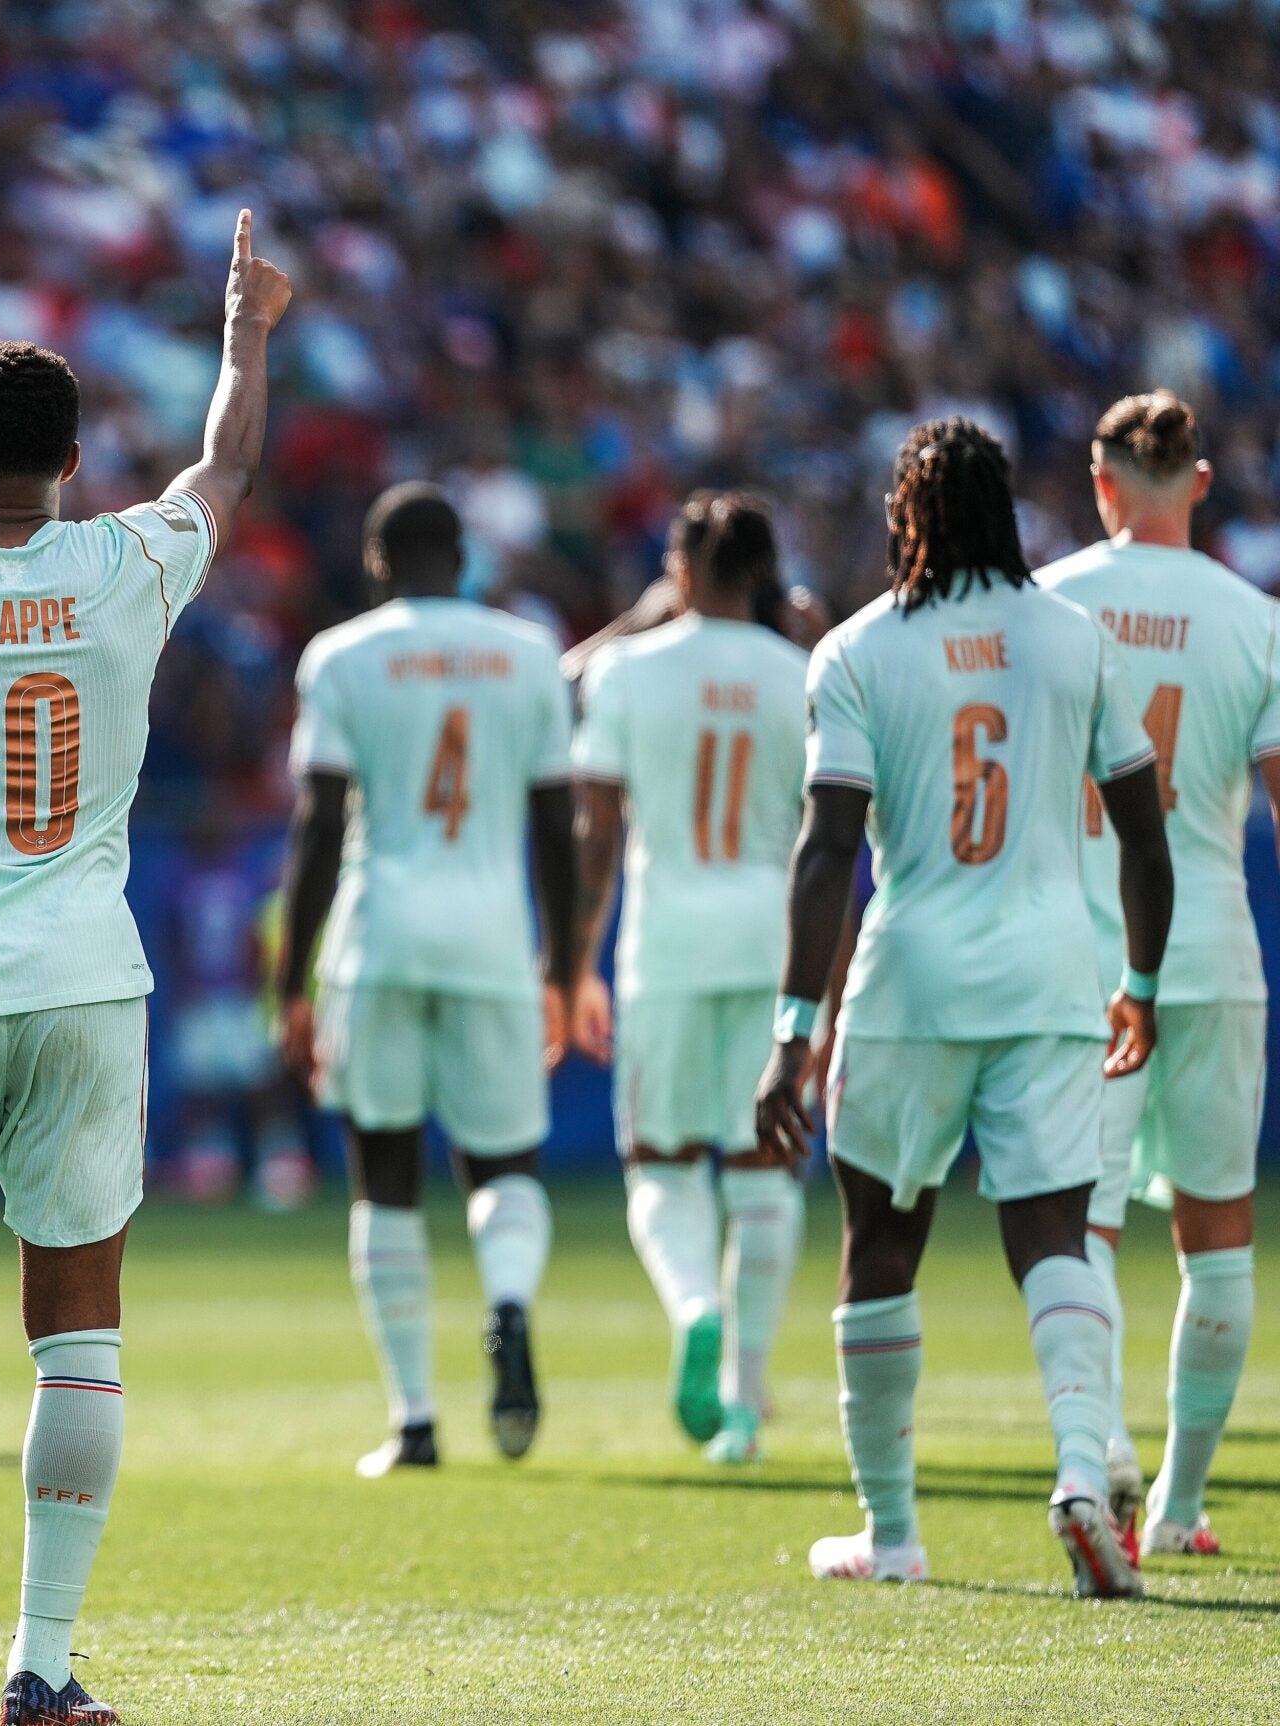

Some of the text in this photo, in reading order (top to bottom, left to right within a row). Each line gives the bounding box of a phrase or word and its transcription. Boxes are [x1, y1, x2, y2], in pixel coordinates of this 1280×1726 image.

[944, 632, 1008, 673] KONE
[424, 706, 470, 841] 4
[694, 729, 752, 863] 11
[951, 703, 1008, 865] 6
[37, 1486, 93, 1505] FFF
